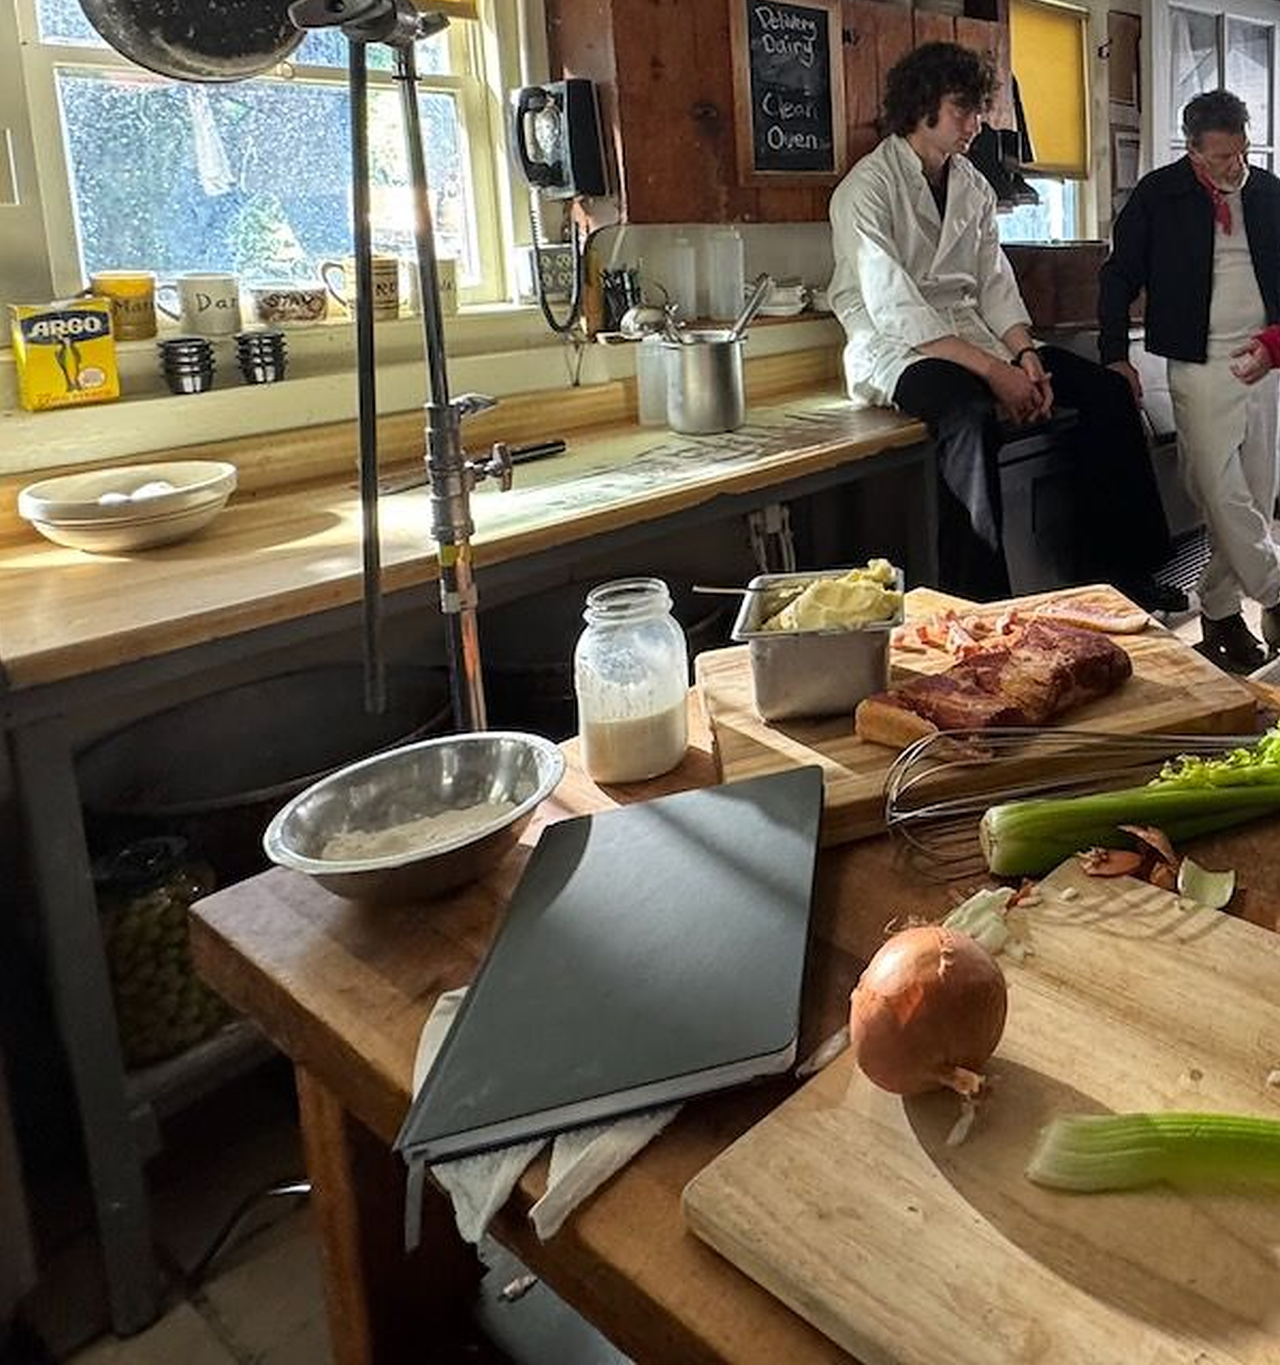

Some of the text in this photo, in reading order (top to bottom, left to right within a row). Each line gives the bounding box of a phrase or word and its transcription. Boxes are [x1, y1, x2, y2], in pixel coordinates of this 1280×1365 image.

[755, 6, 817, 40] Delivery
[762, 34, 814, 67] Dairy
[767, 125, 818, 149] Oven
[28, 316, 102, 337] ARGO
